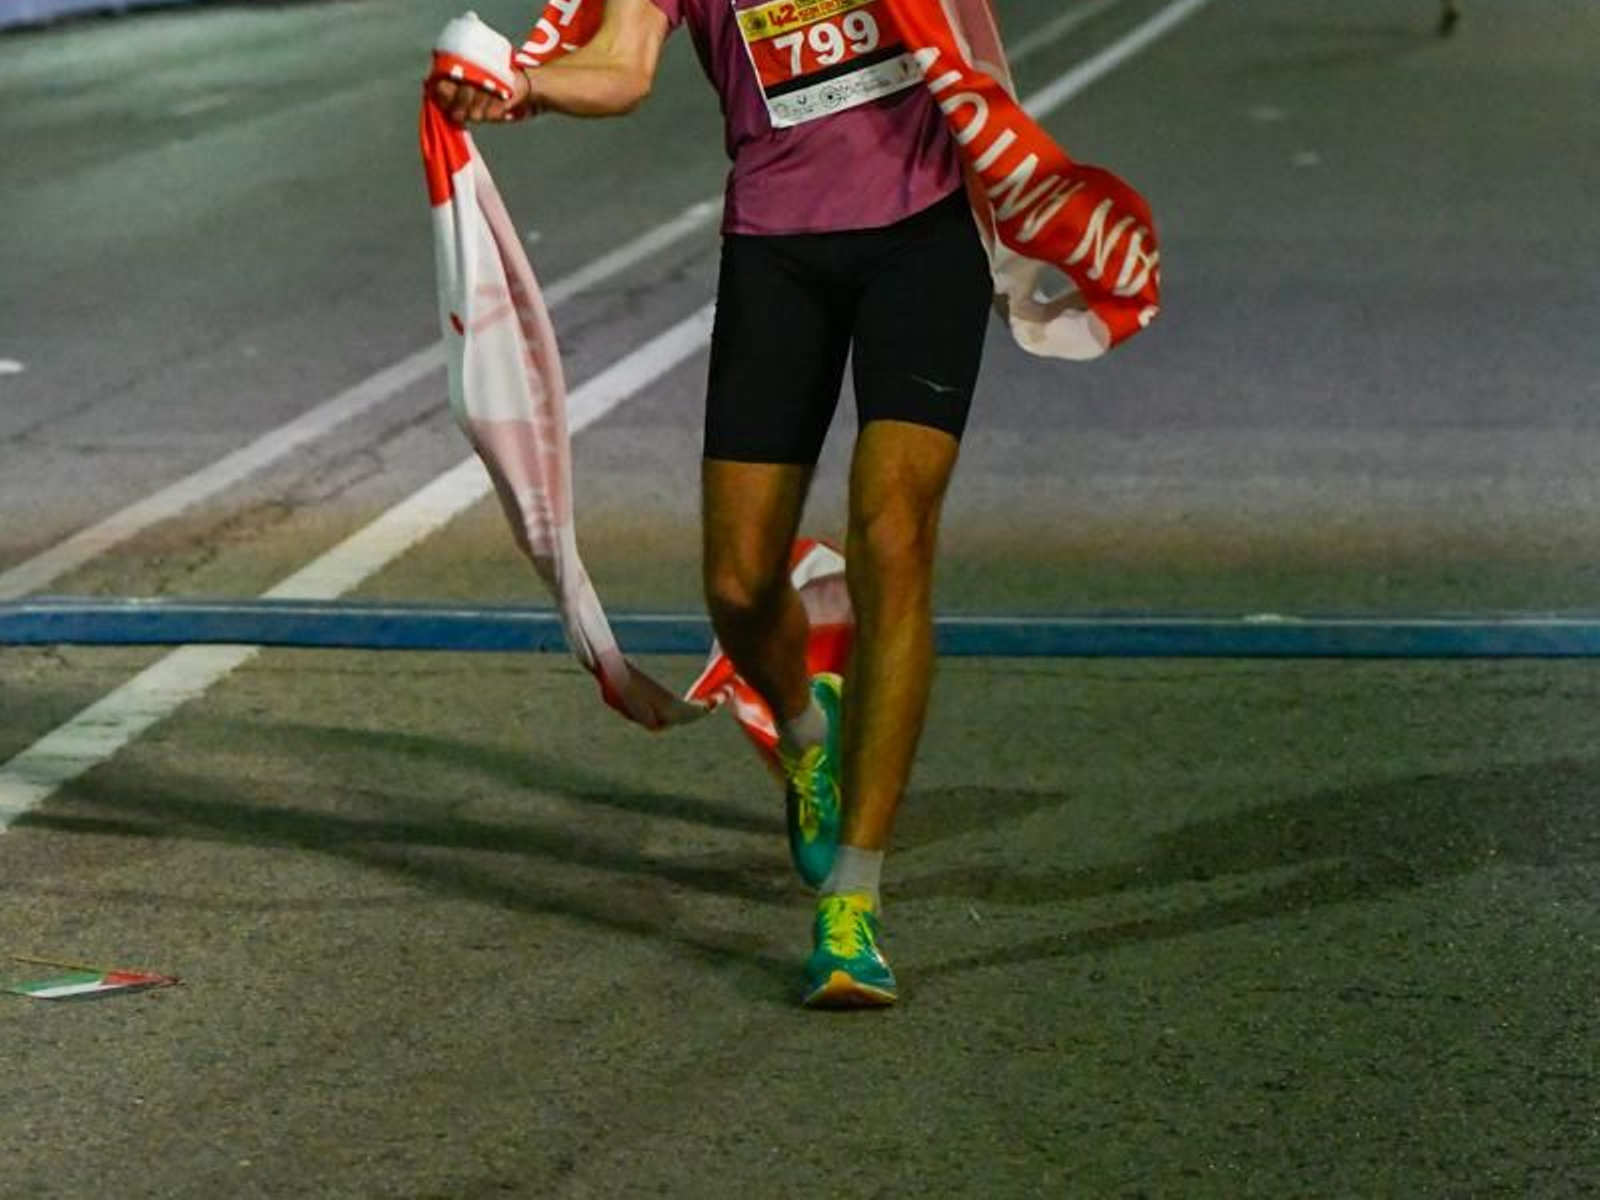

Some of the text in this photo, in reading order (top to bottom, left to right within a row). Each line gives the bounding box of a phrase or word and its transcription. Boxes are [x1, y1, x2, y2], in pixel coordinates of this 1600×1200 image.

[767, 3, 799, 27] 42
[773, 9, 880, 77] 799
[1066, 198, 1160, 327] AN
